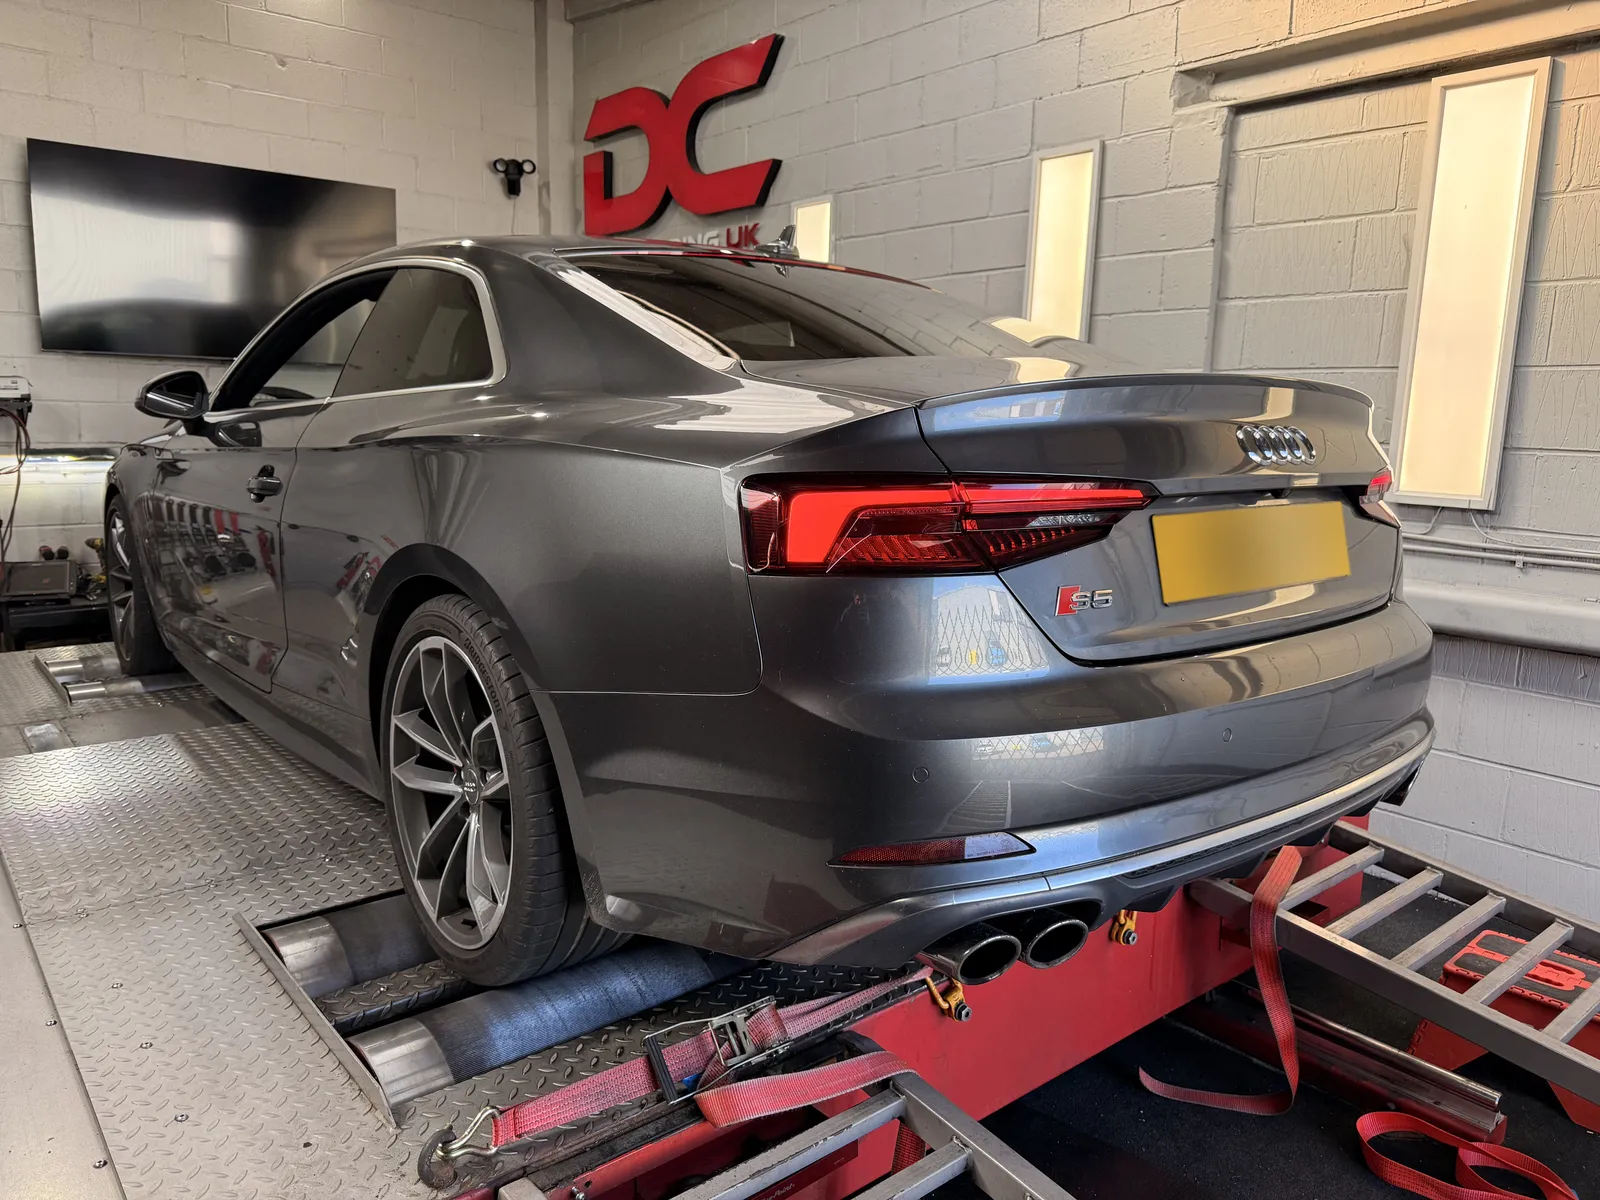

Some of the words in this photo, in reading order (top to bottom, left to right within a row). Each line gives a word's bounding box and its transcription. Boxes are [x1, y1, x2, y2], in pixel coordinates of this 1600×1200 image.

[583, 33, 784, 236] DC
[726, 223, 760, 248] UK
[1067, 589, 1113, 611] S5
[463, 637, 503, 715] BRIDGESTONE
